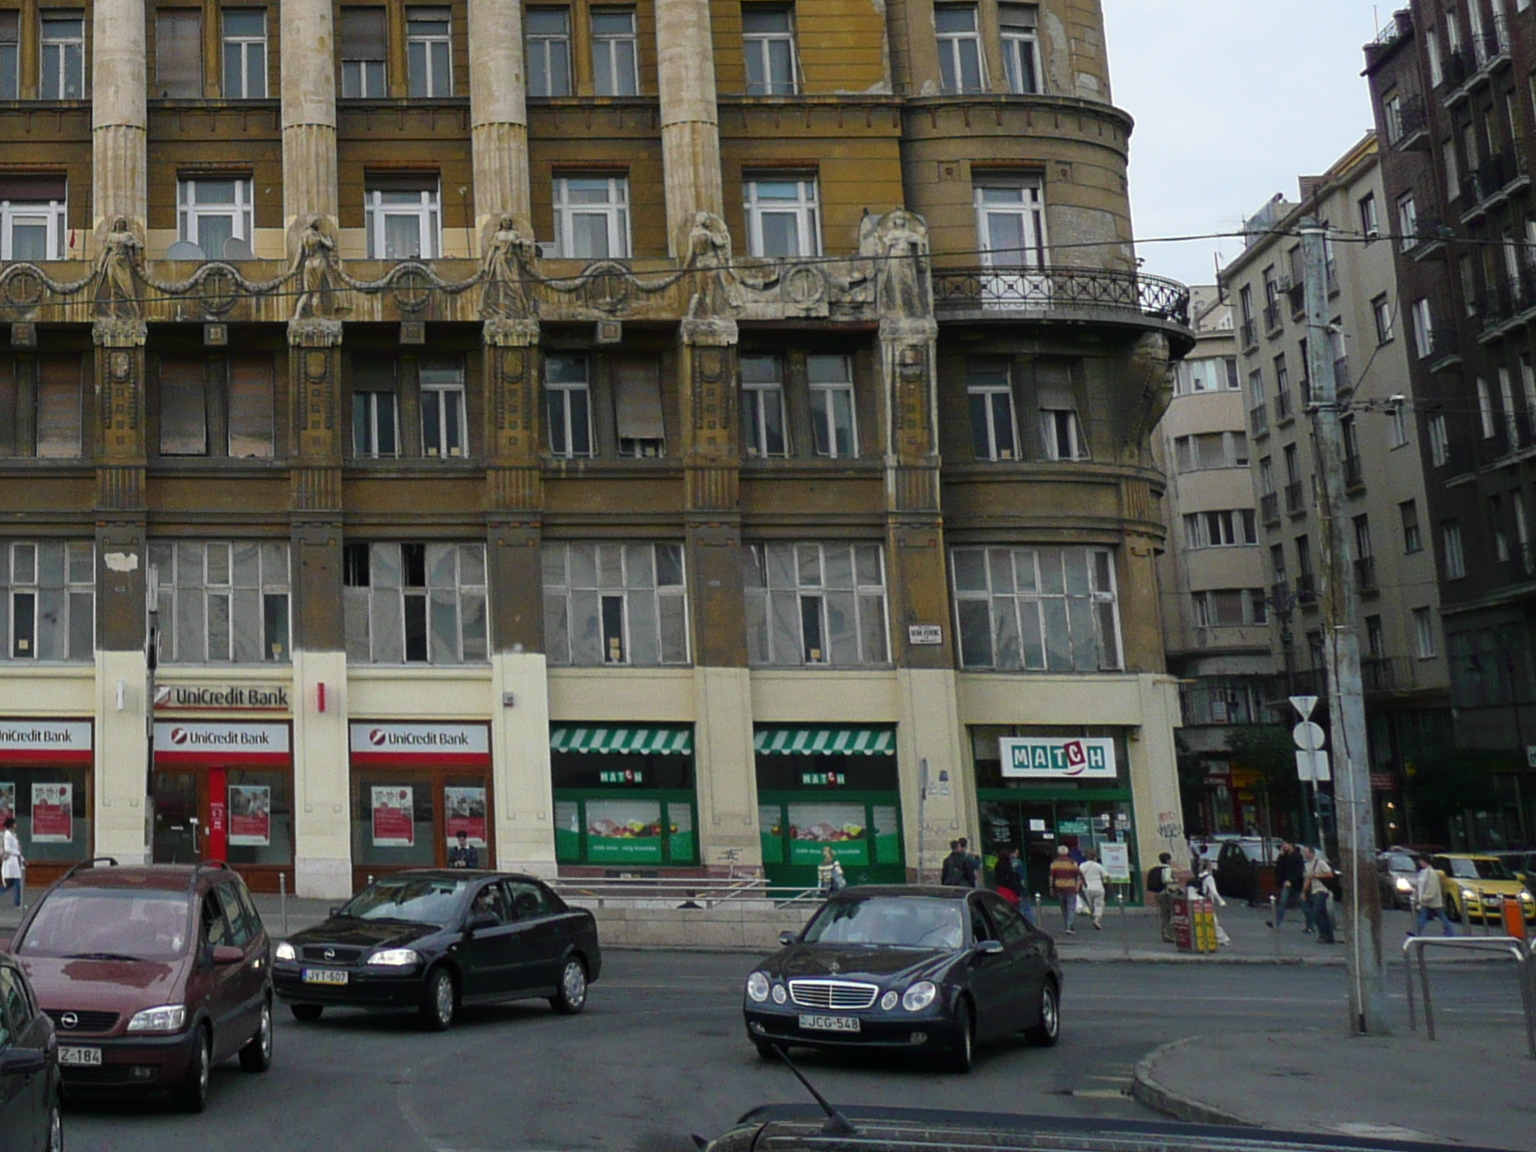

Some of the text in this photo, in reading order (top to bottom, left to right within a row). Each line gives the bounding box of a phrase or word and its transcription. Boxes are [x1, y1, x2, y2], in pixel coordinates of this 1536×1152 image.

[176, 686, 289, 706] UniCredit Bank
[43, 729, 73, 743] Bank
[190, 731, 270, 745] UniCredit Bank
[388, 731, 469, 746] UniCredit Bank
[1014, 744, 1104, 768] MATCH
[600, 769, 643, 783] MATCH
[802, 771, 845, 785] MATCH
[809, 1016, 859, 1030] JCG-548
[61, 1048, 100, 1063] Z-184
